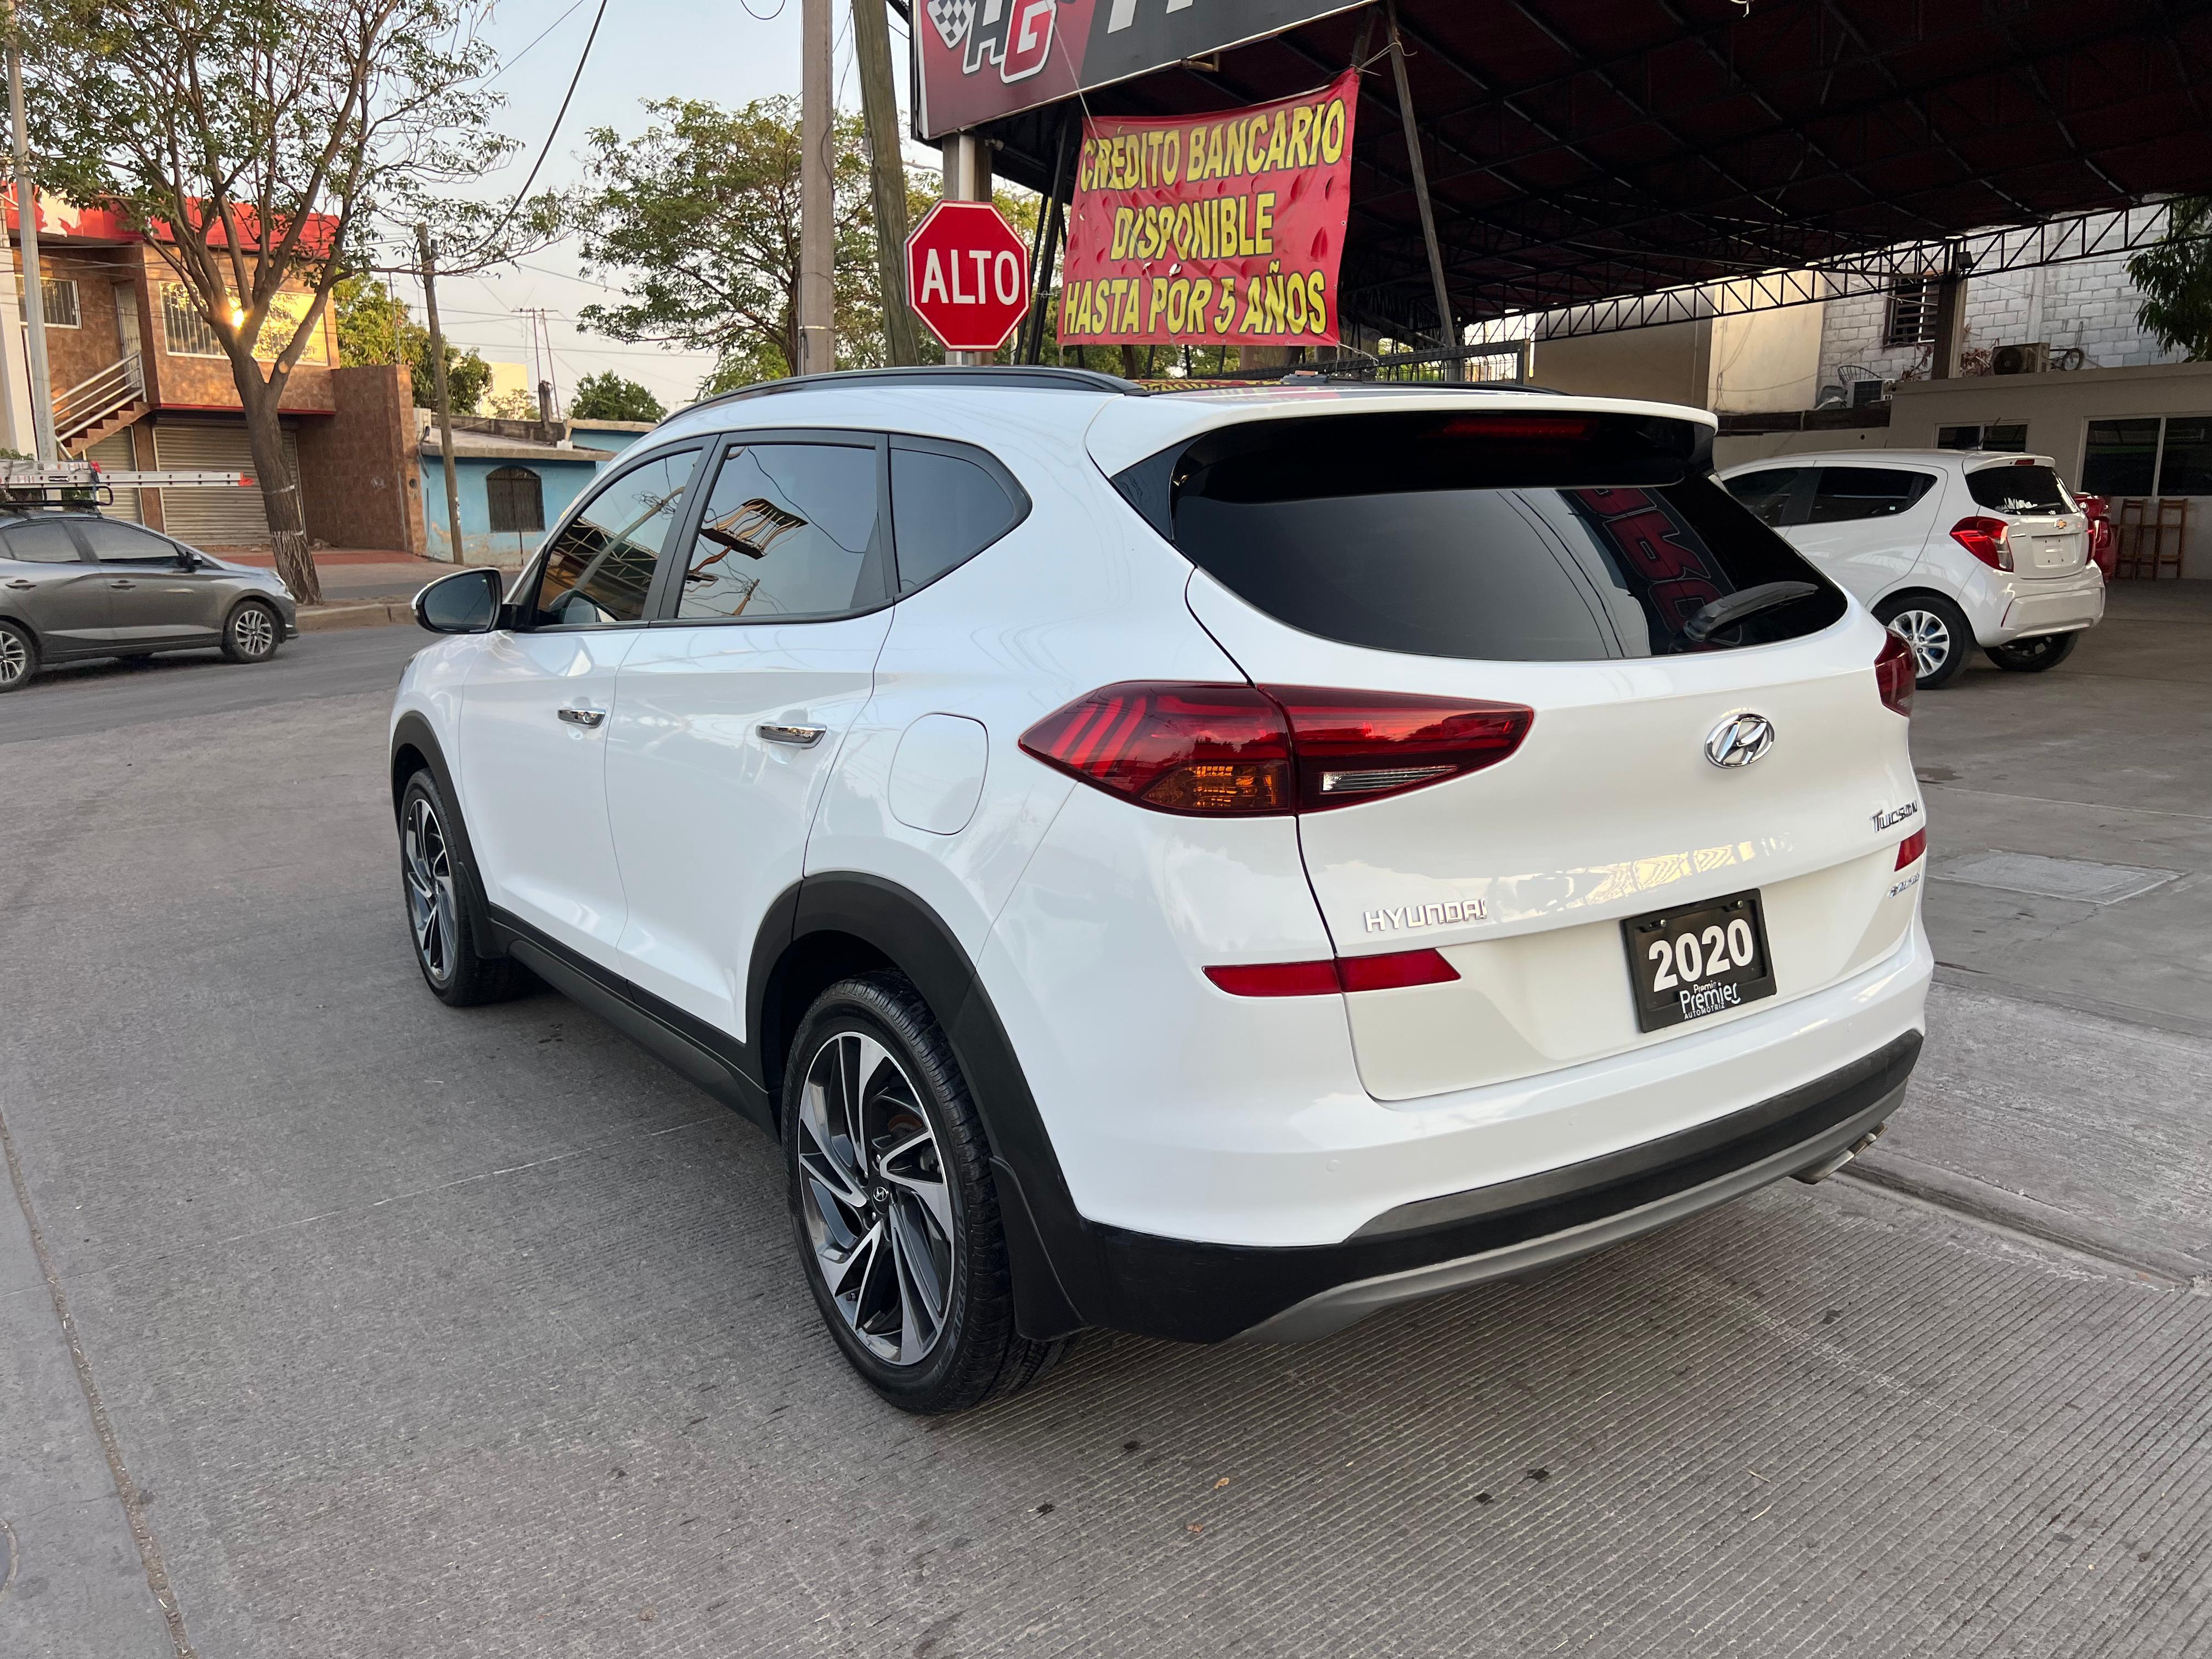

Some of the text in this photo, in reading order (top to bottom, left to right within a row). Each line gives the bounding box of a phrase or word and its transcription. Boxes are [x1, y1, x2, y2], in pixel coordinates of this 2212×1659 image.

[1080, 99, 1345, 192] CRÉDITO BANCARIO
[1110, 192, 1276, 261] DISPONIBLE
[921, 249, 1019, 305] ALTO
[1063, 259, 1327, 335] HASTA POR 5 AÑOS
[1364, 899, 1487, 932] HYUNDAI
[1649, 918, 1753, 992] 2020
[1680, 982, 1737, 1013] Premier
[1684, 1002, 1725, 1020] AUTOMOTRIZ
